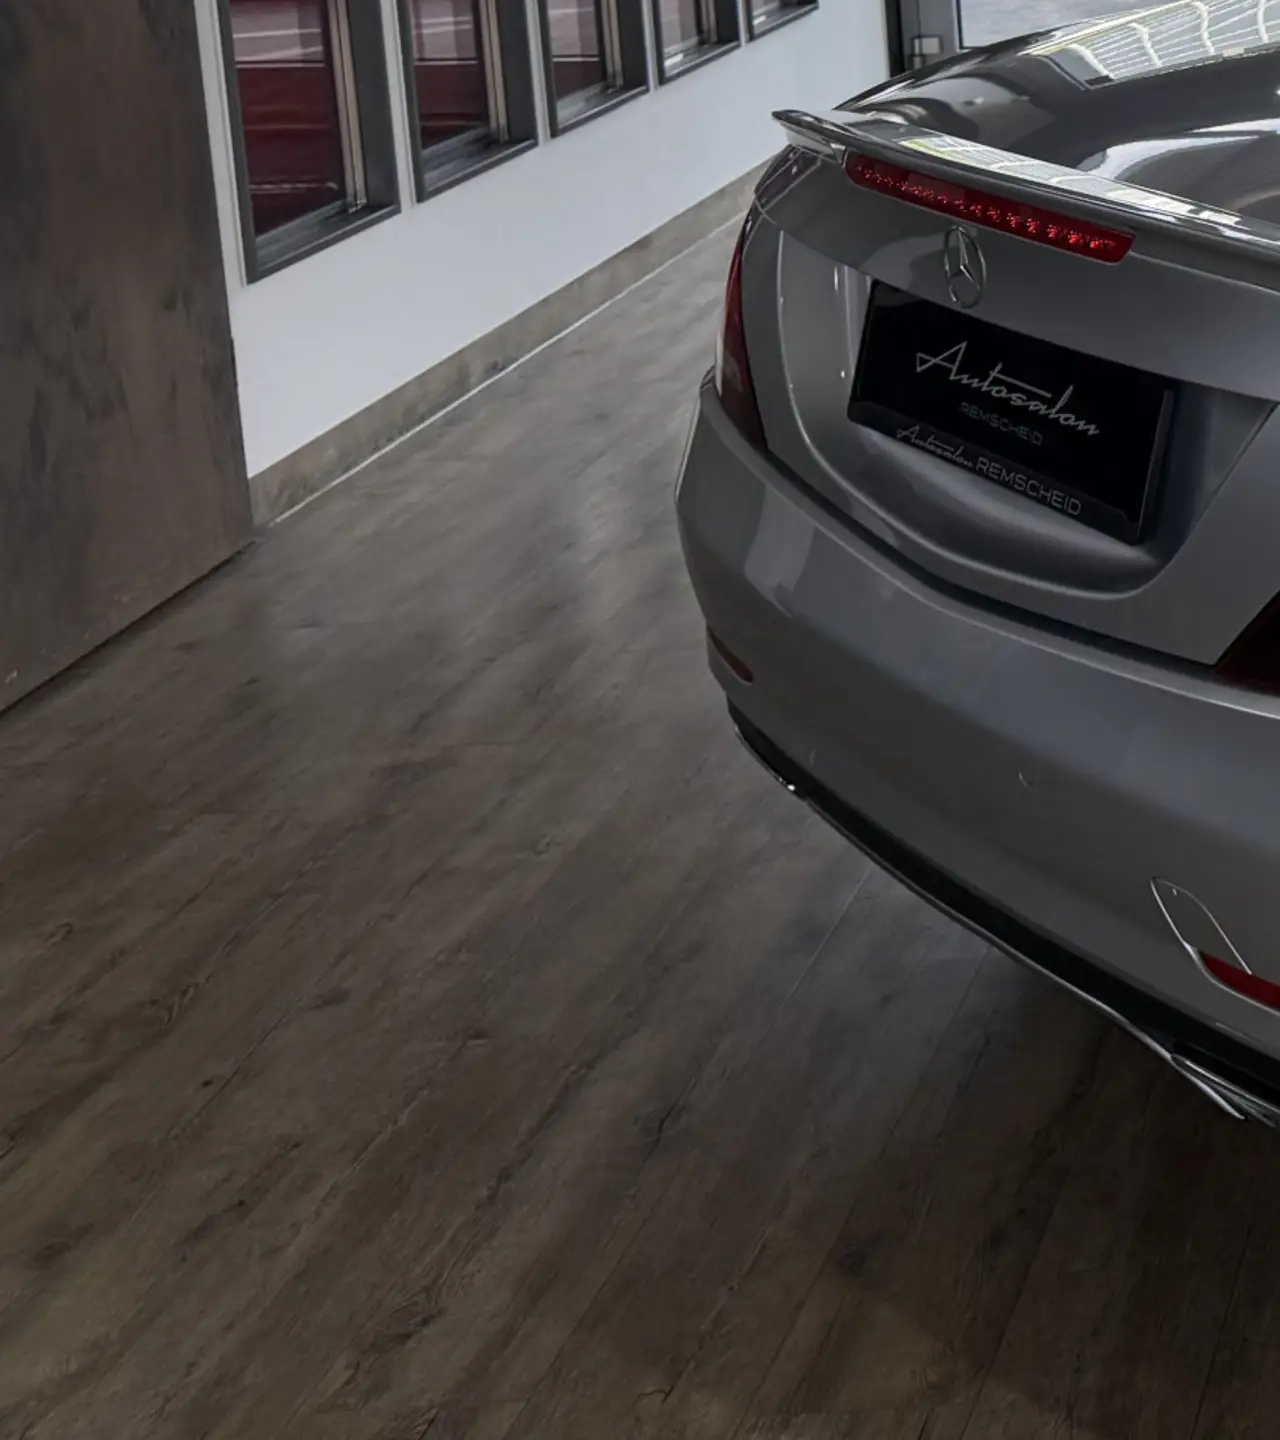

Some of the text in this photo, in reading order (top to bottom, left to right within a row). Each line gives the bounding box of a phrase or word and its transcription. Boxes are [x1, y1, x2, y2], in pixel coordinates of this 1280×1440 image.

[916, 340, 1100, 436] Autosalon
[959, 402, 1044, 446] REMSCHEID
[975, 456, 1082, 516] REMSCHEID
